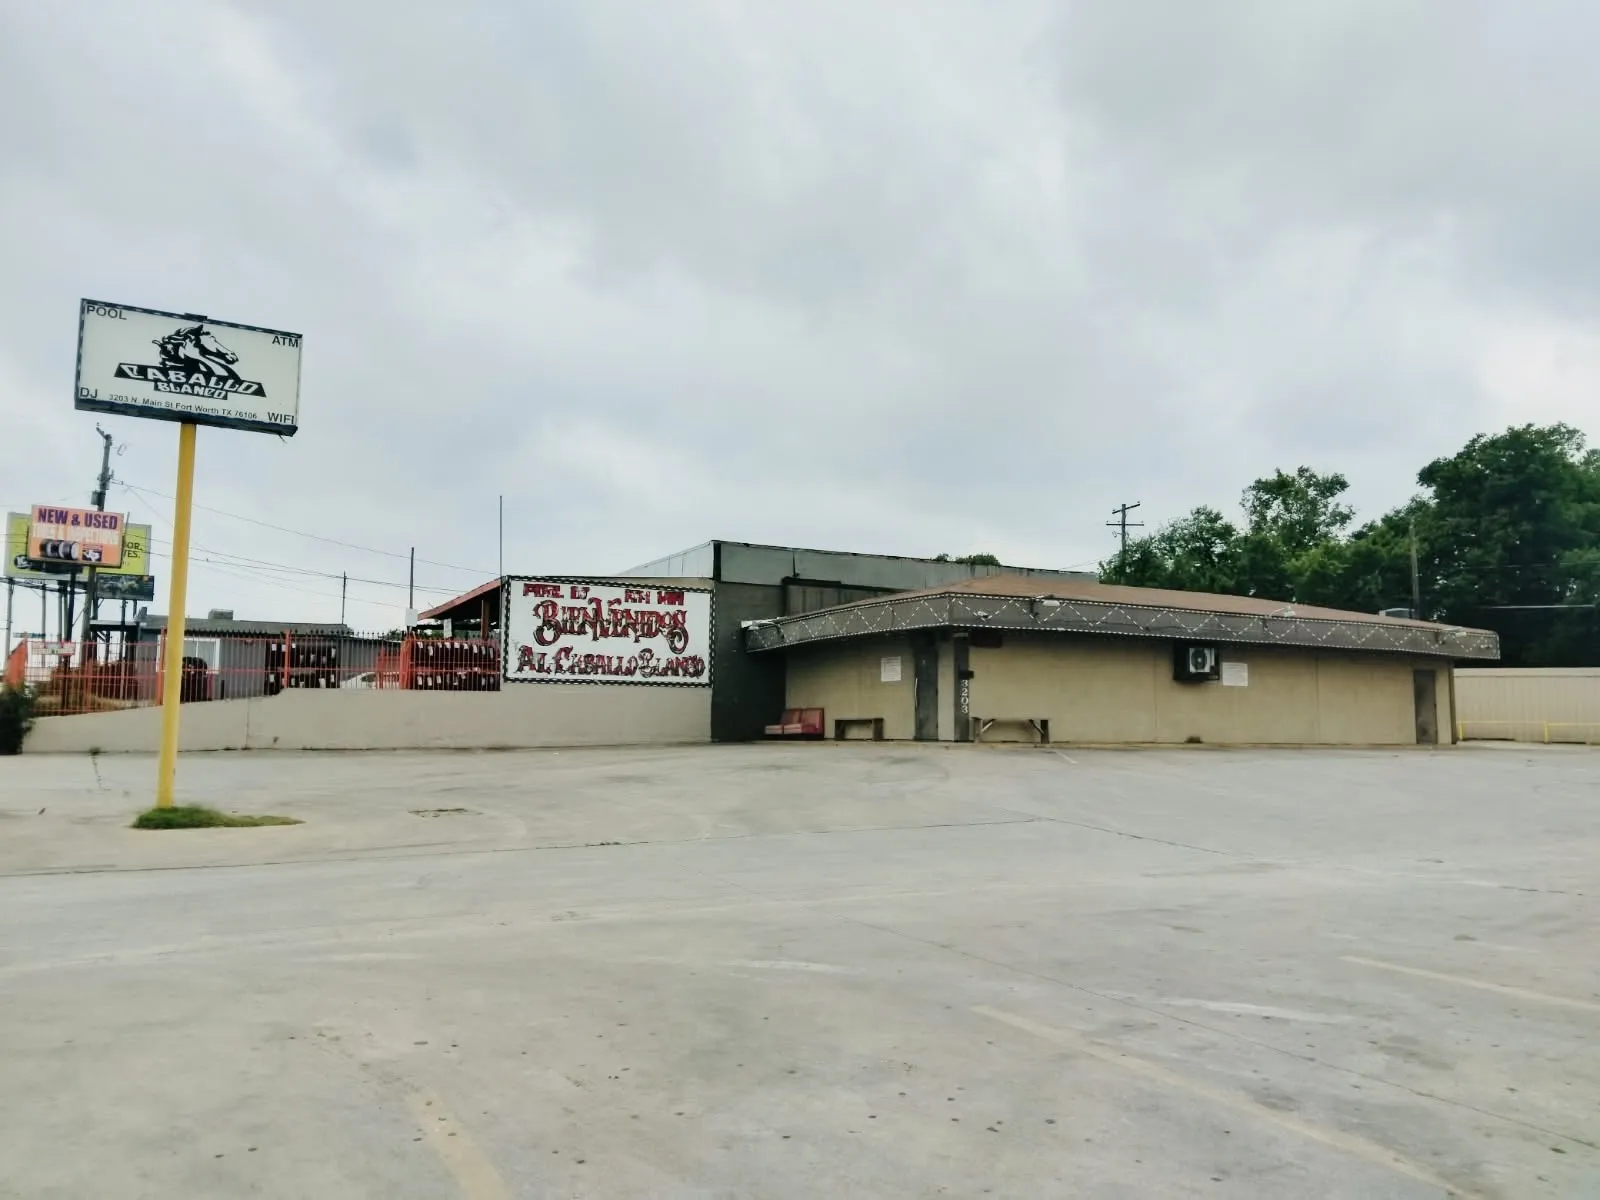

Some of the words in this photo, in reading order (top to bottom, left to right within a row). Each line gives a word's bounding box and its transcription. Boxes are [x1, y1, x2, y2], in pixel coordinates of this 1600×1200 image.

[86, 305, 127, 321] POOL
[271, 335, 299, 348] ATM
[120, 363, 260, 395] CABALLO
[80, 387, 98, 399] DJ
[157, 381, 227, 400] BLANCO
[109, 394, 129, 403] 3203
[142, 398, 162, 407] Main
[164, 401, 173, 409] St
[175, 402, 192, 411] Fort
[194, 405, 219, 415] Worth
[222, 408, 232, 416] TX
[234, 410, 258, 420] 76106
[267, 411, 295, 425] WIFI
[37, 507, 68, 525] NEW
[71, 513, 81, 527] &
[84, 512, 118, 530] USED
[961, 679, 969, 714] 3203
